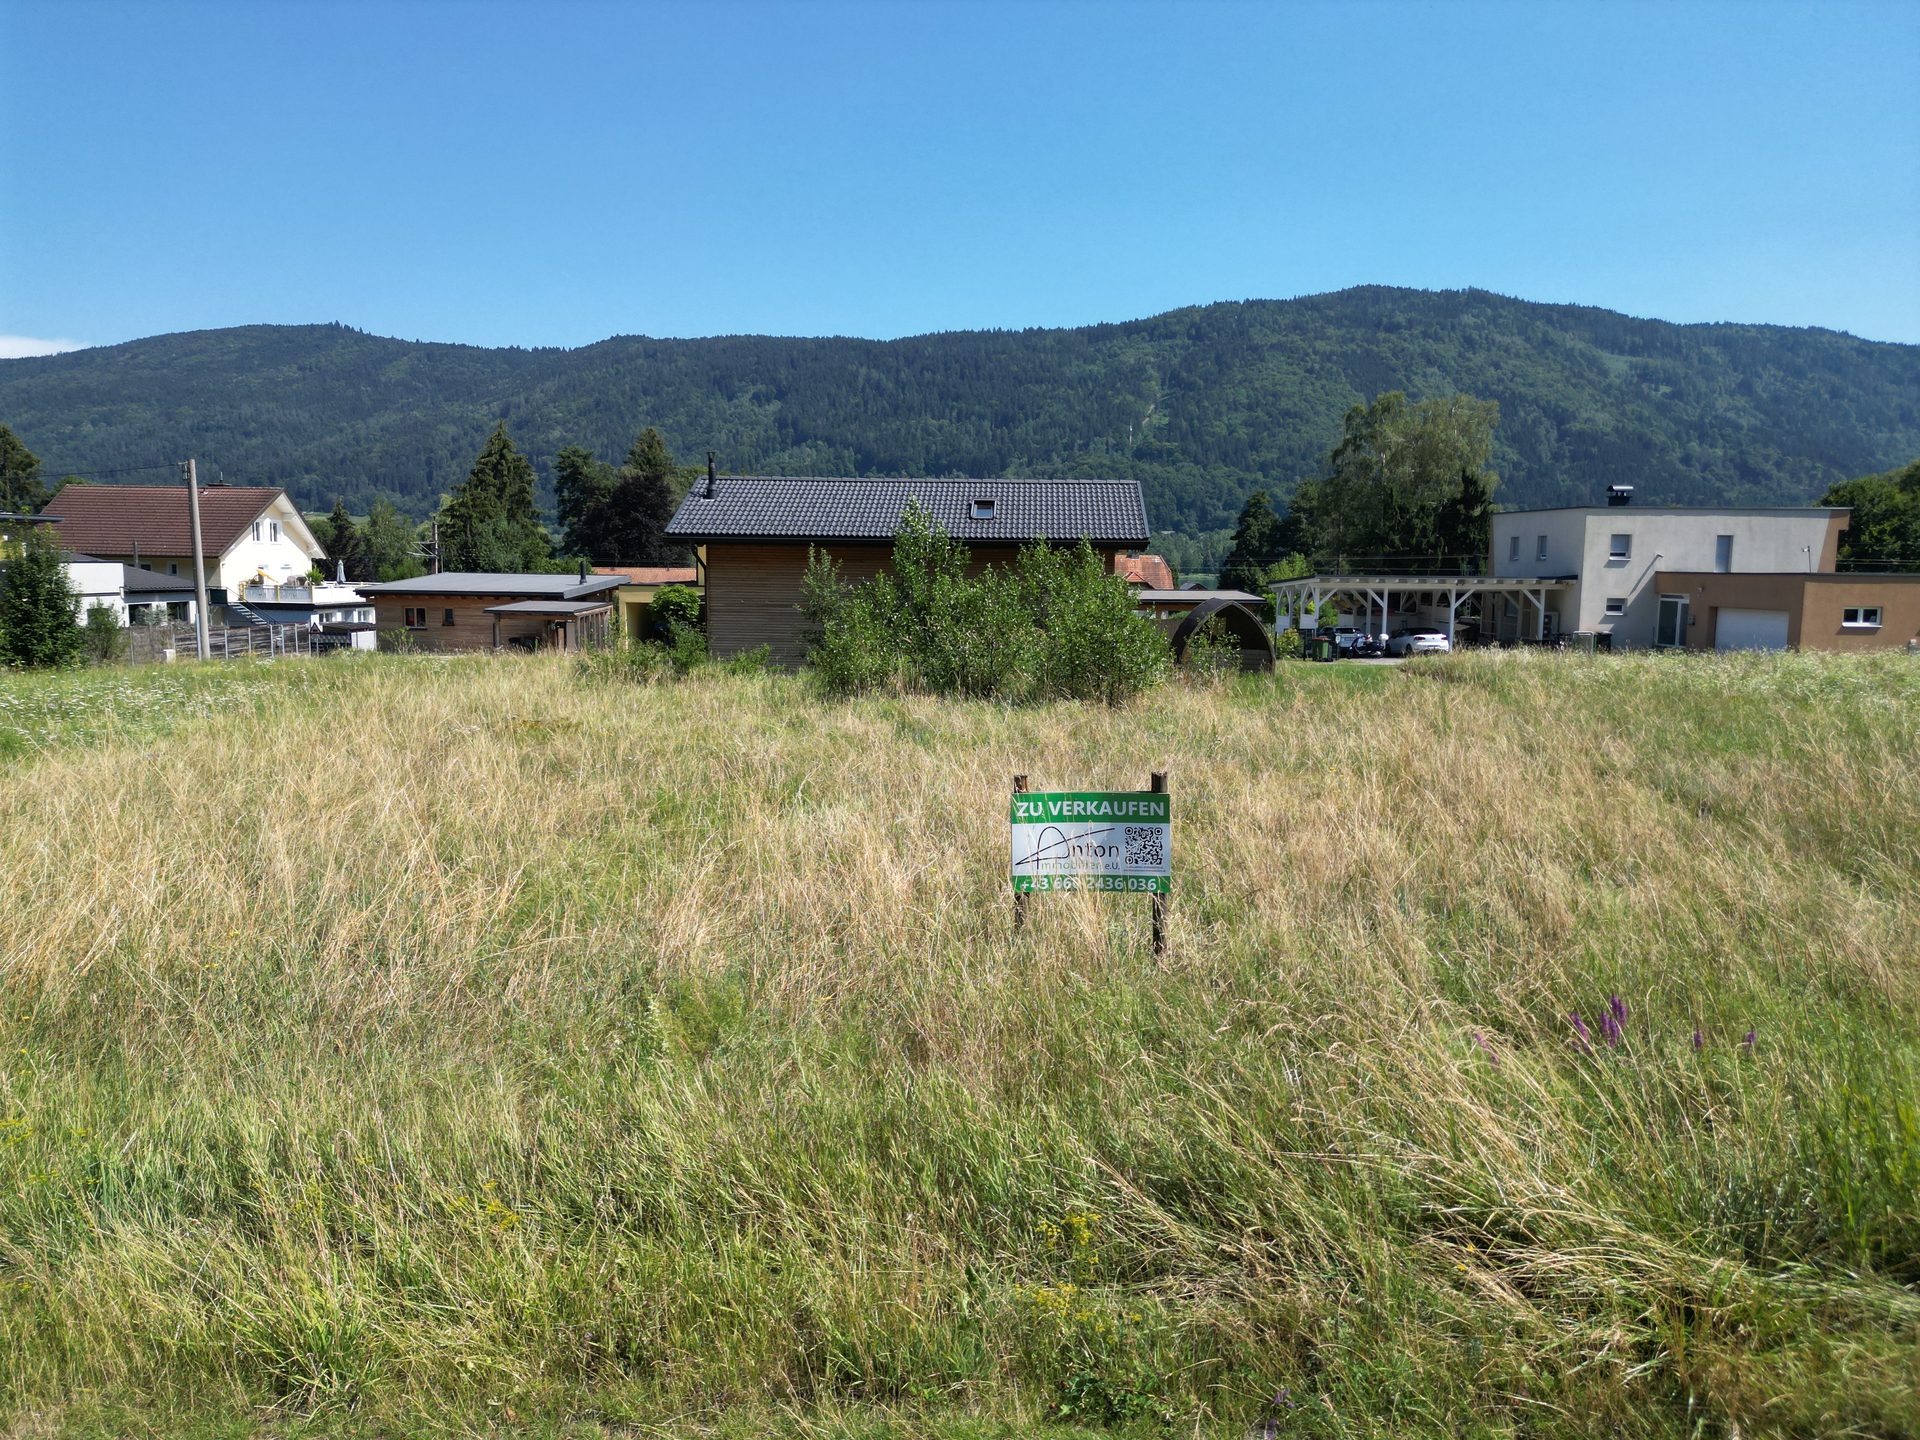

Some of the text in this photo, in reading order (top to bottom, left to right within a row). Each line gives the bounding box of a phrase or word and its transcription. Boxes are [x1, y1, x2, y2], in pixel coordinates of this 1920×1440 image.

[1016, 800, 1164, 817] ZU VERKAUFEN
[1105, 862, 1120, 870] e.U.
[1086, 878, 1124, 890] 2436
[1128, 878, 1157, 890] 036
